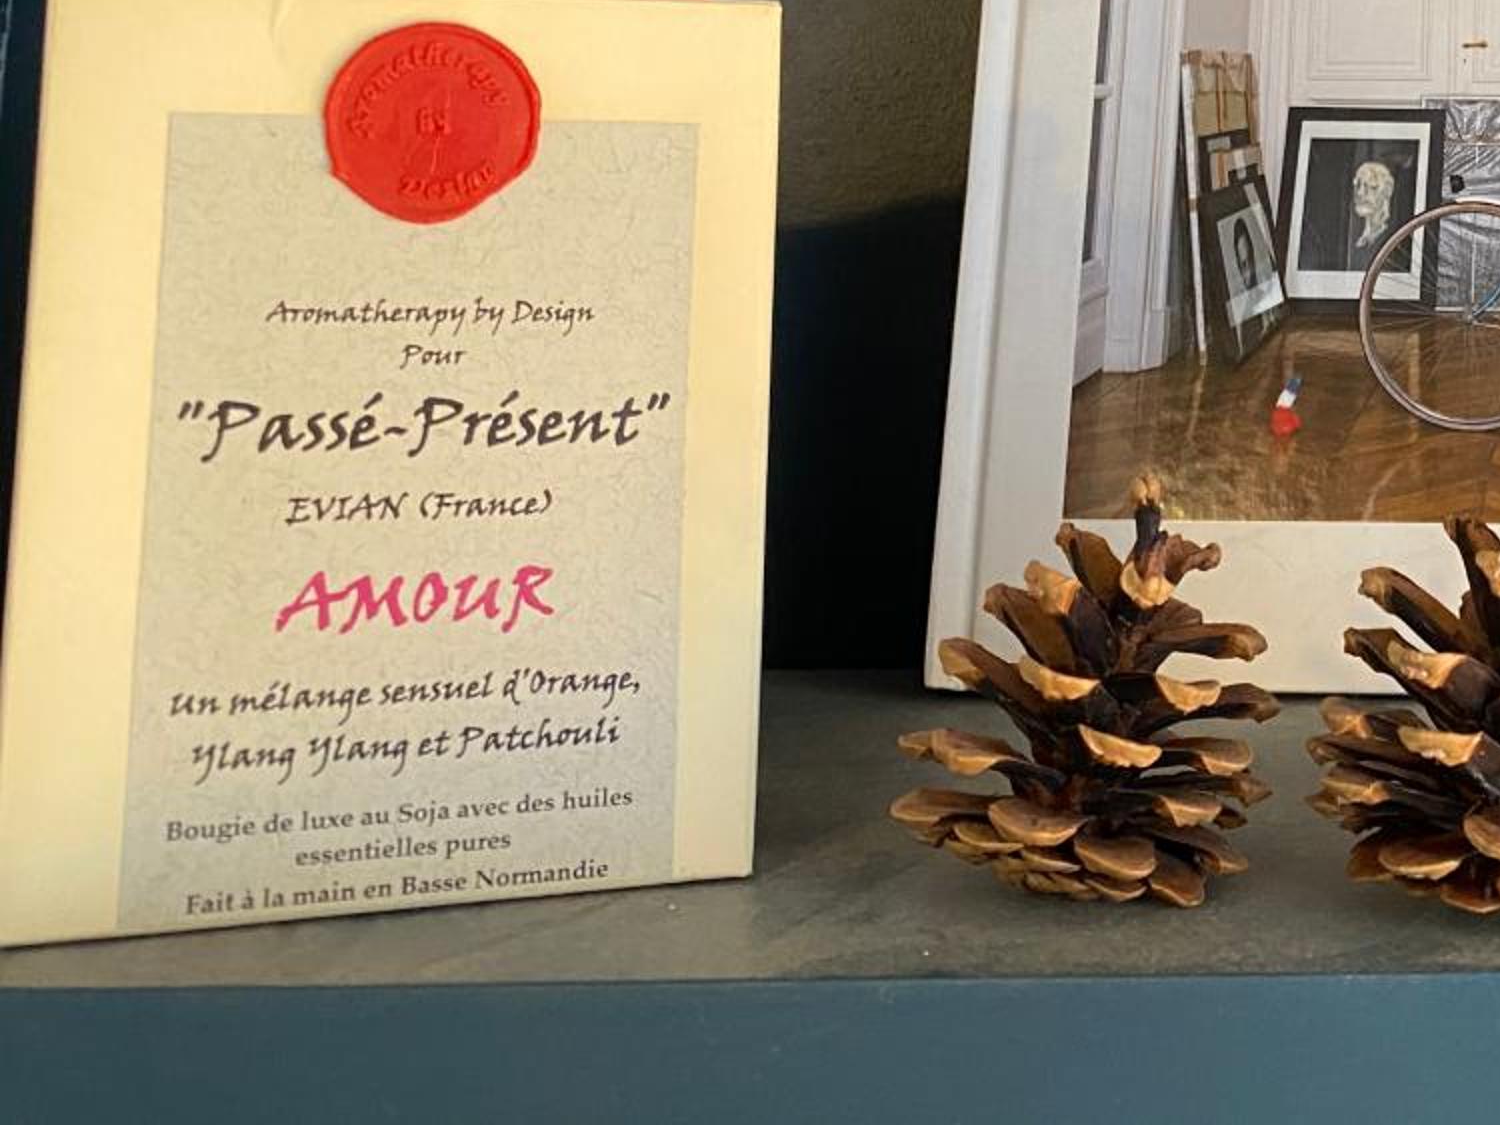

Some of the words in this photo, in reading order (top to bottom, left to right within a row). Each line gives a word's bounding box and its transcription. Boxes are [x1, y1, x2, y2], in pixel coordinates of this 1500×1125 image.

[265, 298, 468, 337] Aromatherapy
[471, 295, 506, 337] by
[510, 299, 596, 337] Design
[399, 343, 467, 370] Pour
[284, 491, 410, 527] EVIAN
[418, 488, 553, 521] (France)
[275, 564, 555, 636] AMOUR
[169, 692, 222, 717] Un
[228, 680, 373, 727] mélange
[378, 670, 495, 706] sensuel
[191, 740, 297, 786] Ylang
[307, 732, 410, 778] Ylang
[416, 729, 452, 758] et
[455, 715, 621, 759] Patchouli
[166, 815, 256, 844] Bougie
[262, 812, 294, 834] de
[301, 810, 355, 832] luxe
[359, 810, 390, 826] au
[396, 799, 451, 828] Soja
[456, 801, 510, 819] avec
[515, 792, 556, 814] des
[562, 786, 633, 810] huiles
[295, 835, 438, 866] essentielles
[444, 834, 512, 860] pures
[186, 891, 234, 915] Fait
[240, 890, 255, 910] à
[263, 887, 285, 908] la
[292, 880, 356, 906] main
[362, 883, 392, 899] en
[401, 875, 468, 896] Basse
[475, 858, 609, 889] Normandie
